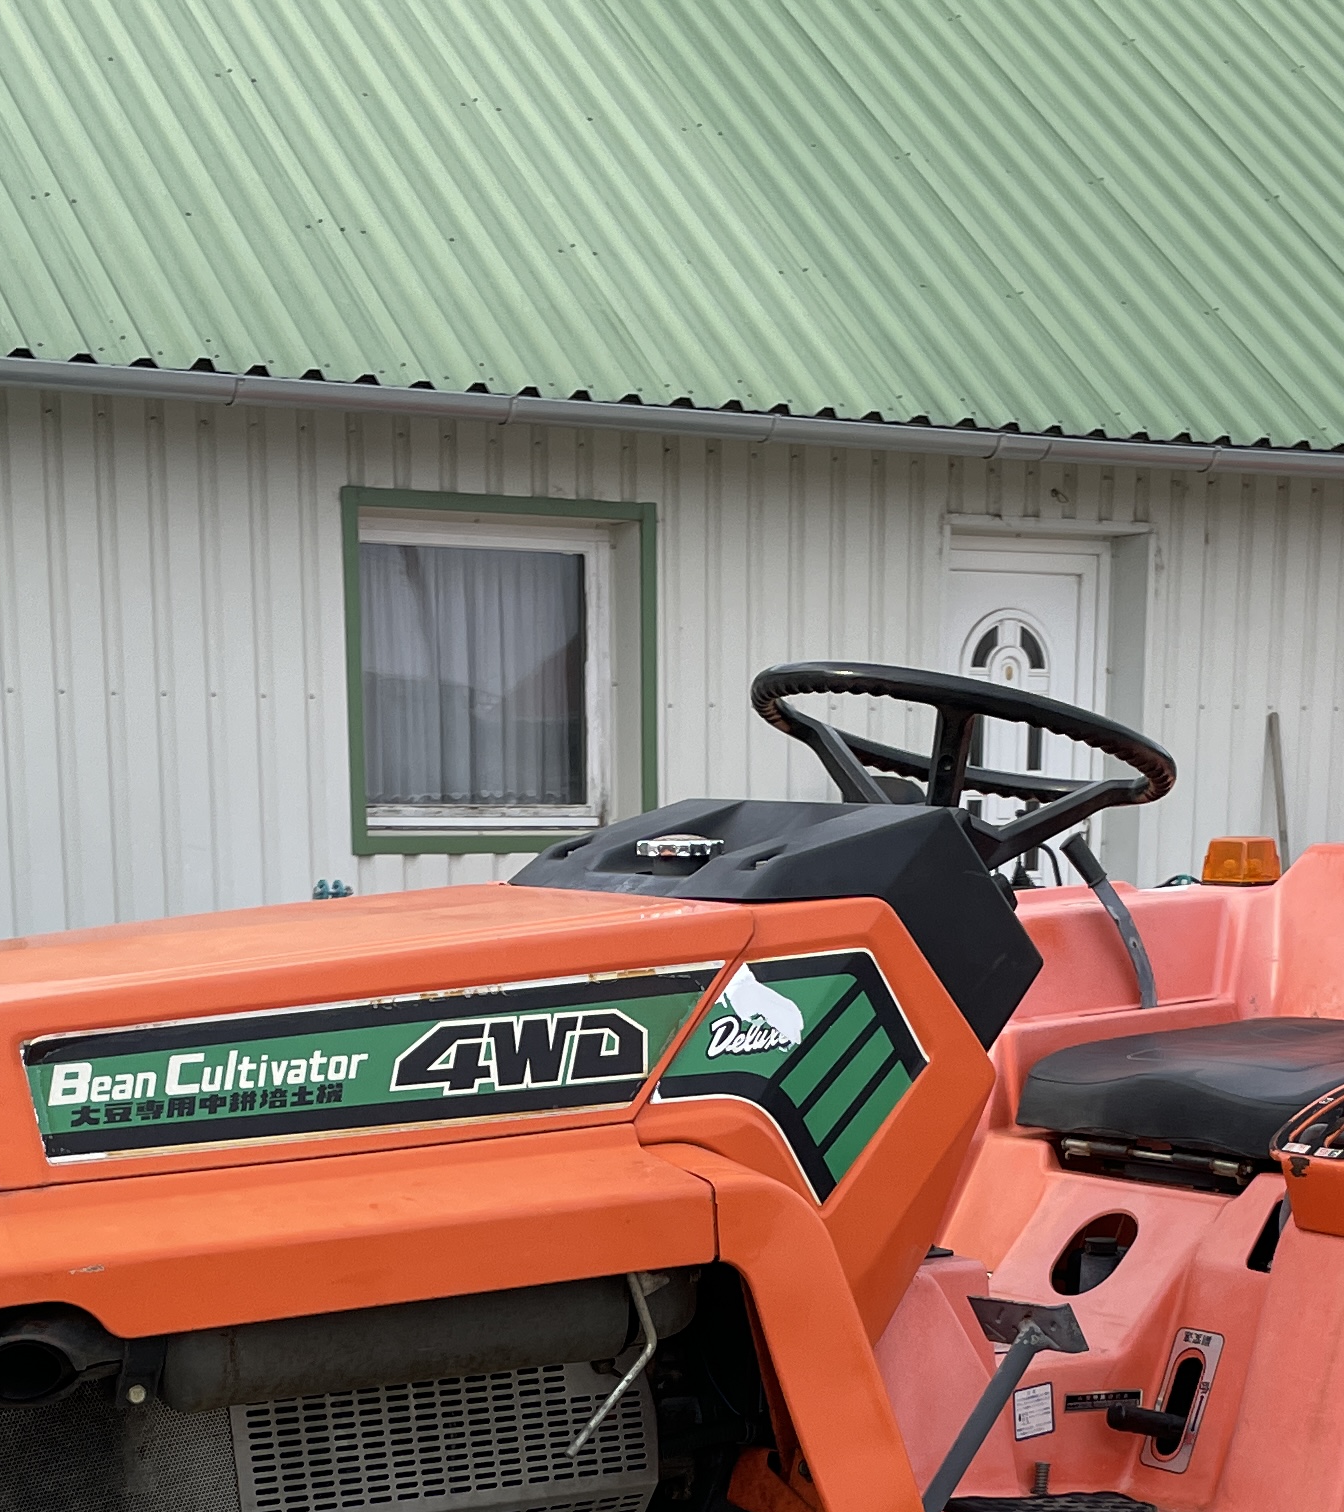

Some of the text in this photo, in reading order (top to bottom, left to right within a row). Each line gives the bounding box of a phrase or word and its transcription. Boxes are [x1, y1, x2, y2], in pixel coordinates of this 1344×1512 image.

[47, 1008, 649, 1106] Bean Cultivator 4WD
